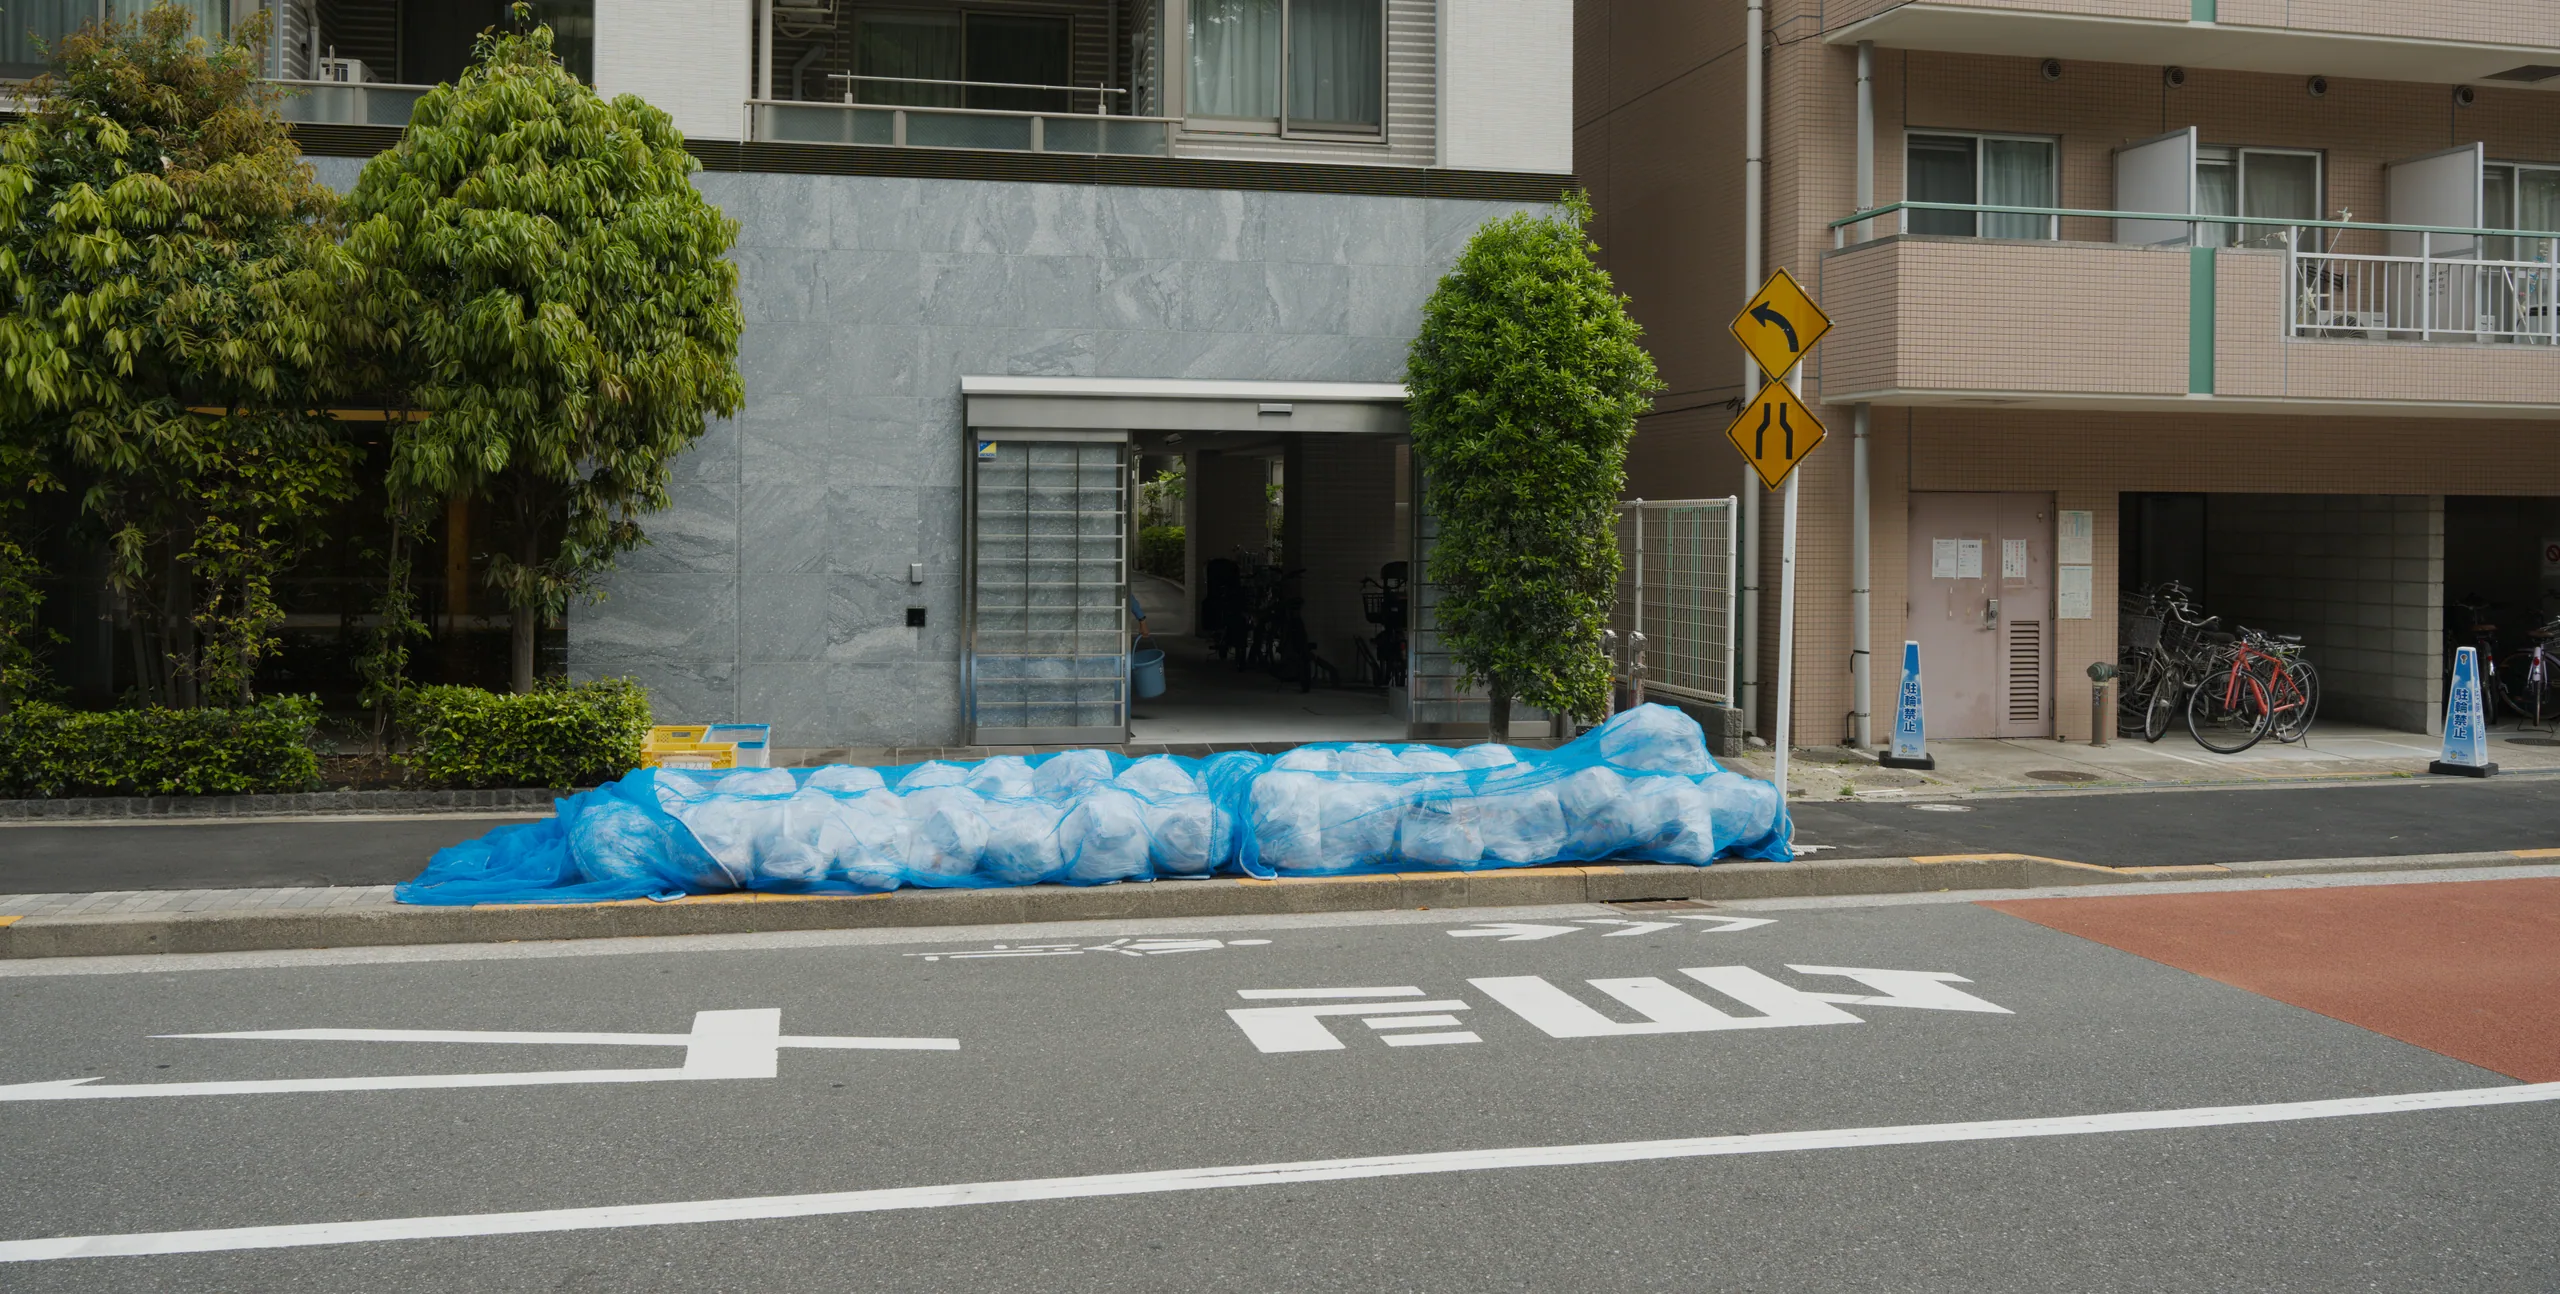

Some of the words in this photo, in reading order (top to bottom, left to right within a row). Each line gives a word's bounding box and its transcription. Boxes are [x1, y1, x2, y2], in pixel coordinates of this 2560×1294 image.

[1904, 682, 1917, 733] 駐輪禁止
[2454, 688, 2469, 739] 駐輪禁止
